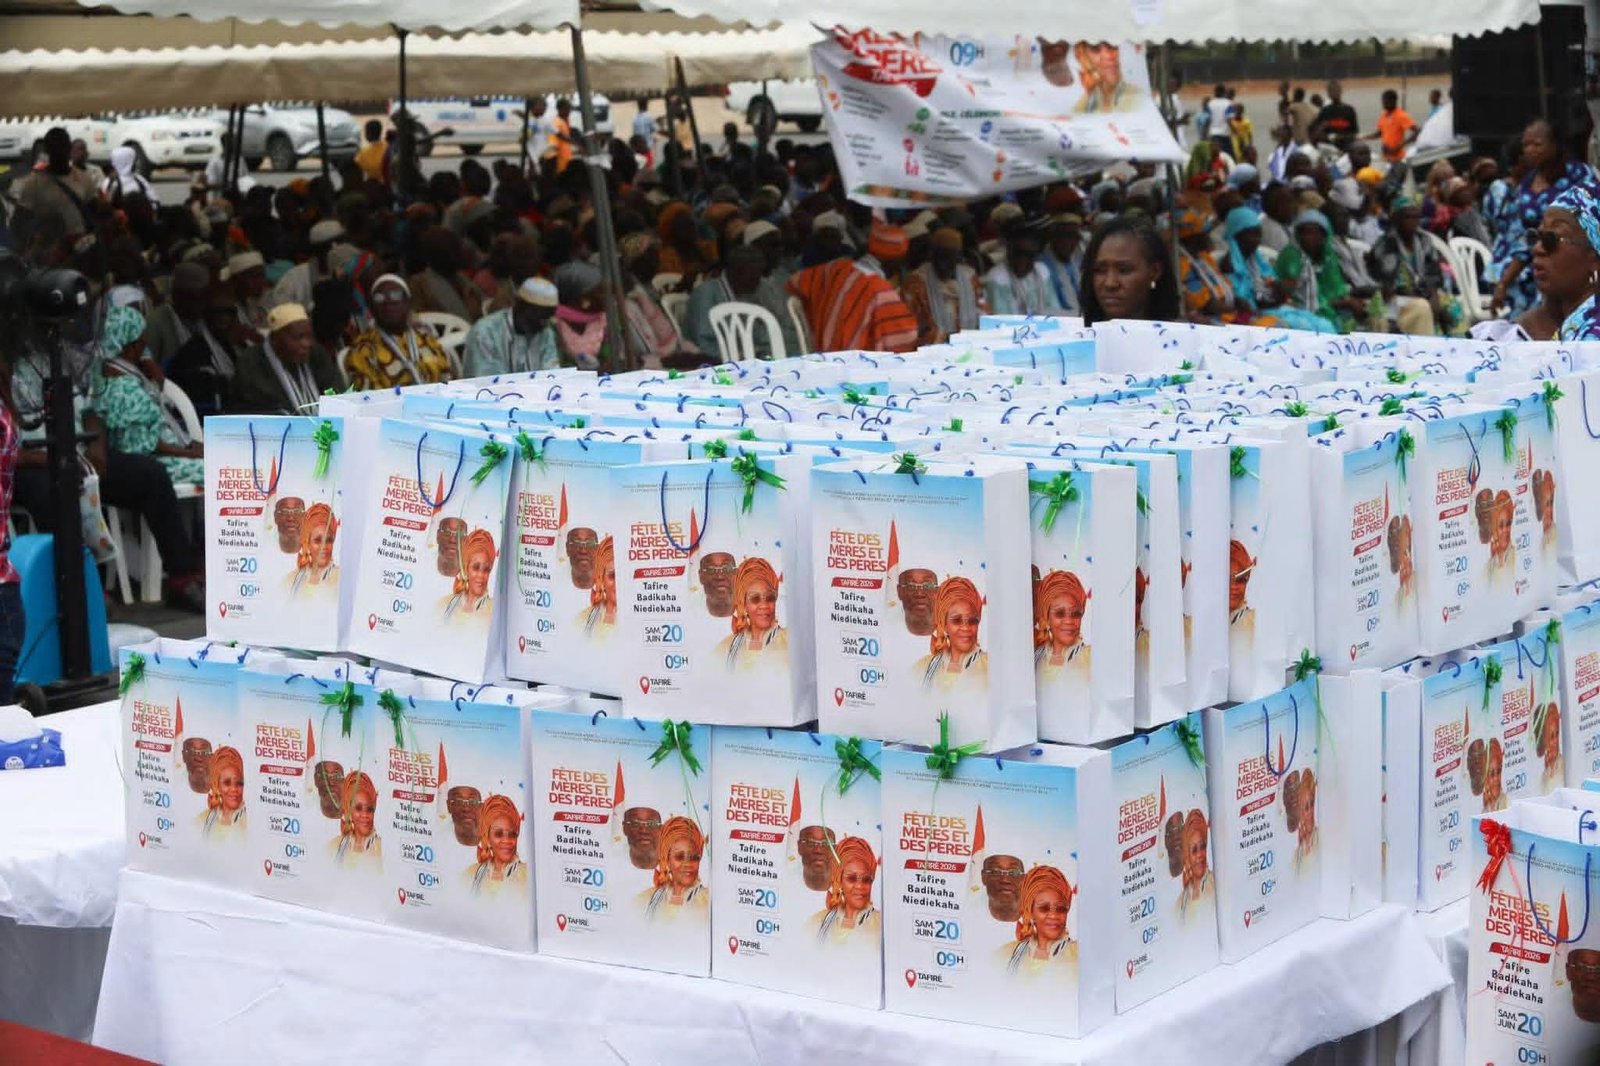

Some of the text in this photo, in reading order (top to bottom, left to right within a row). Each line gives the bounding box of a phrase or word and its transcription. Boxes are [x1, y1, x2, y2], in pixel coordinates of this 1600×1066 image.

[951, 41, 985, 66] 09H
[859, 534, 880, 545] DES
[629, 550, 650, 561] DES
[870, 547, 883, 559] ET
[240, 558, 257, 574] 20
[827, 558, 848, 569] DES
[1456, 556, 1467, 573] 20
[395, 572, 413, 590] 20
[643, 582, 668, 590] Tafire
[536, 590, 551, 608] 20
[637, 593, 676, 601] Badikaha
[840, 592, 866, 602] Tafire
[1367, 589, 1378, 608] 20
[634, 605, 681, 613] Niediekaha
[835, 602, 873, 614] Badikaha
[831, 613, 878, 627] Niediekaha
[662, 625, 682, 642] 20
[858, 638, 878, 657] 20
[665, 655, 688, 669] 09H
[861, 669, 883, 684] 09H
[585, 772, 608, 784] DES
[596, 785, 610, 796] ET
[762, 788, 785, 801] DES
[155, 792, 170, 809] 20
[550, 793, 573, 805] DES
[773, 802, 787, 814] ET
[727, 810, 749, 822] DES
[940, 817, 966, 829] DES
[1449, 810, 1459, 829] 20
[283, 817, 300, 834] 20
[564, 825, 591, 836] Tafire
[557, 835, 599, 847] Badikaha
[953, 831, 969, 843] ET
[553, 845, 603, 859] Niediekaha
[740, 844, 766, 855] Tafire
[900, 839, 926, 852] DES
[416, 845, 433, 863] 20
[733, 854, 773, 867] Badikaha
[1260, 850, 1273, 871] 20
[582, 868, 604, 886] 20
[728, 864, 777, 879] Niediekaha
[916, 874, 946, 885] Tafire
[908, 884, 954, 898] Badikaha
[585, 898, 608, 911] 09H
[755, 889, 776, 908] 20
[903, 895, 959, 910] Niediekaha
[1141, 896, 1155, 918] 20
[756, 920, 780, 934] 09H
[915, 929, 933, 937] JUIN
[935, 921, 959, 940] 20
[1486, 919, 1511, 936] DES
[937, 952, 964, 967] 09H
[1492, 969, 1537, 990] Badikaha
[1487, 981, 1542, 1004] Niediekaha
[1498, 1020, 1516, 1030] JUIN
[1518, 1013, 1541, 1036] 20
[1519, 1047, 1545, 1065] 09H
